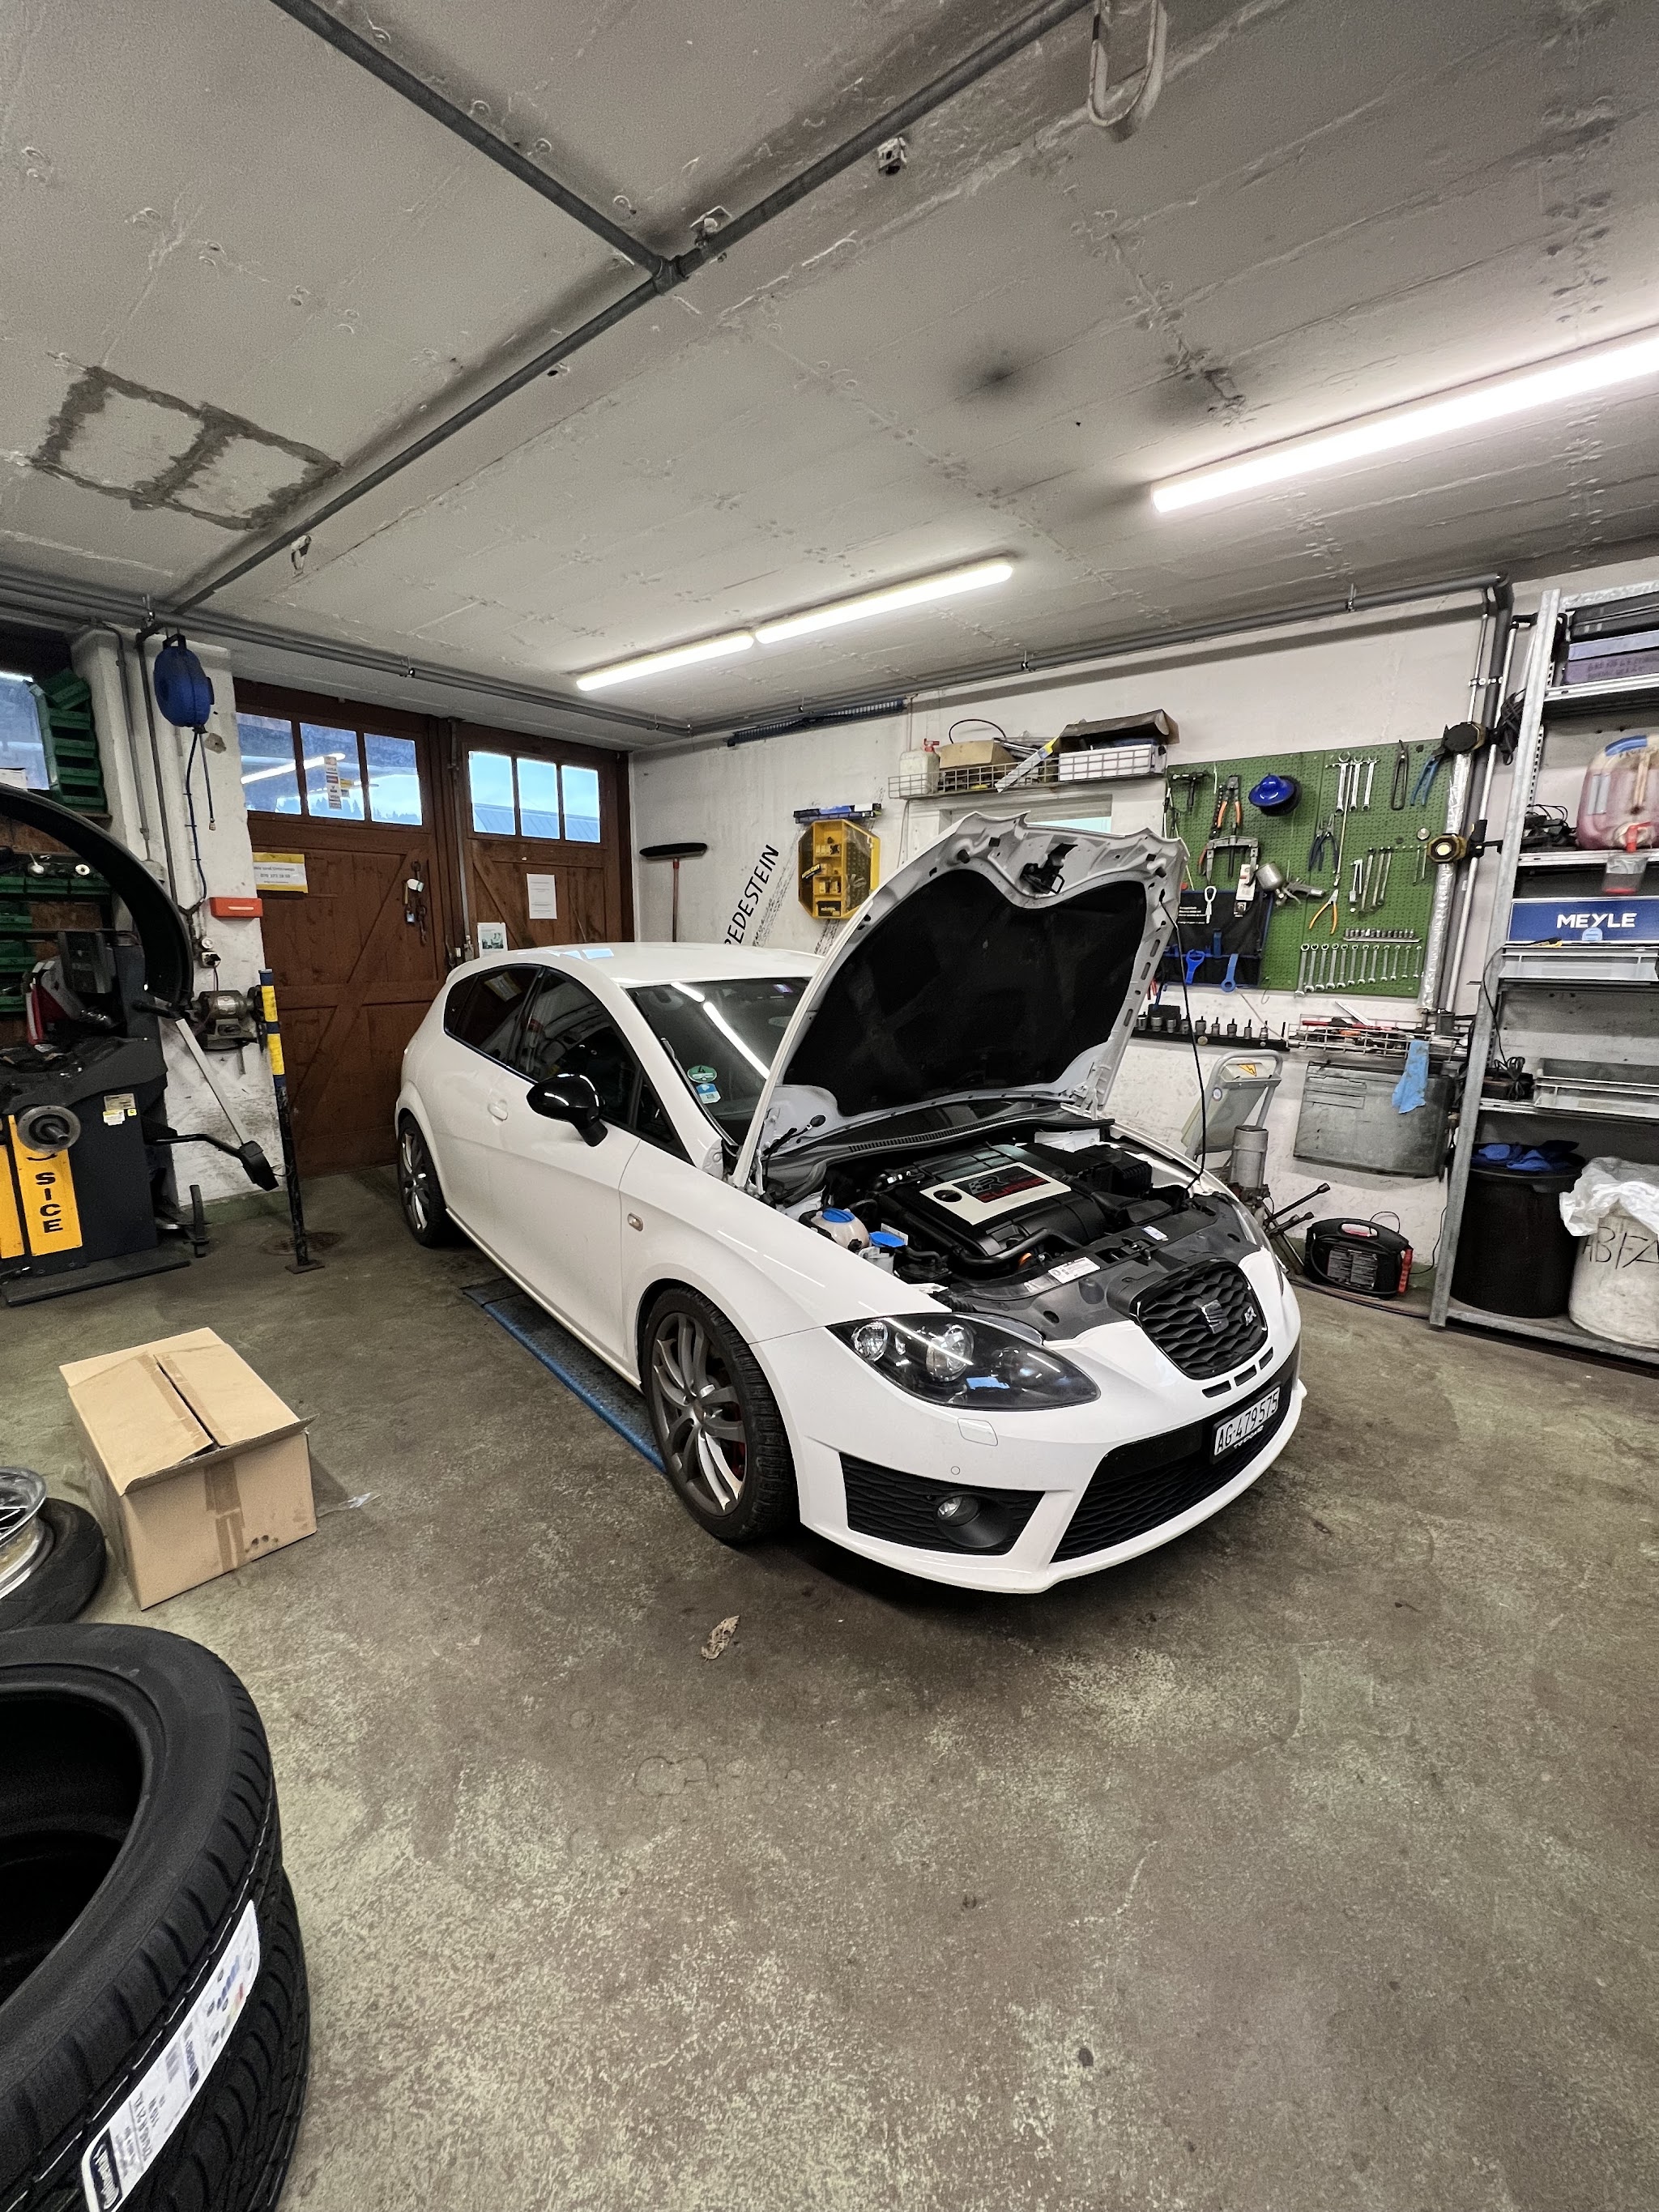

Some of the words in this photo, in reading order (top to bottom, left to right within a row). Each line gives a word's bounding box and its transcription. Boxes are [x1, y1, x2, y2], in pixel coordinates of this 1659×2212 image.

[724, 844, 779, 944] EDESTEIN
[1556, 913, 1637, 929] MEYLE
[35, 1172, 63, 1233] SICE
